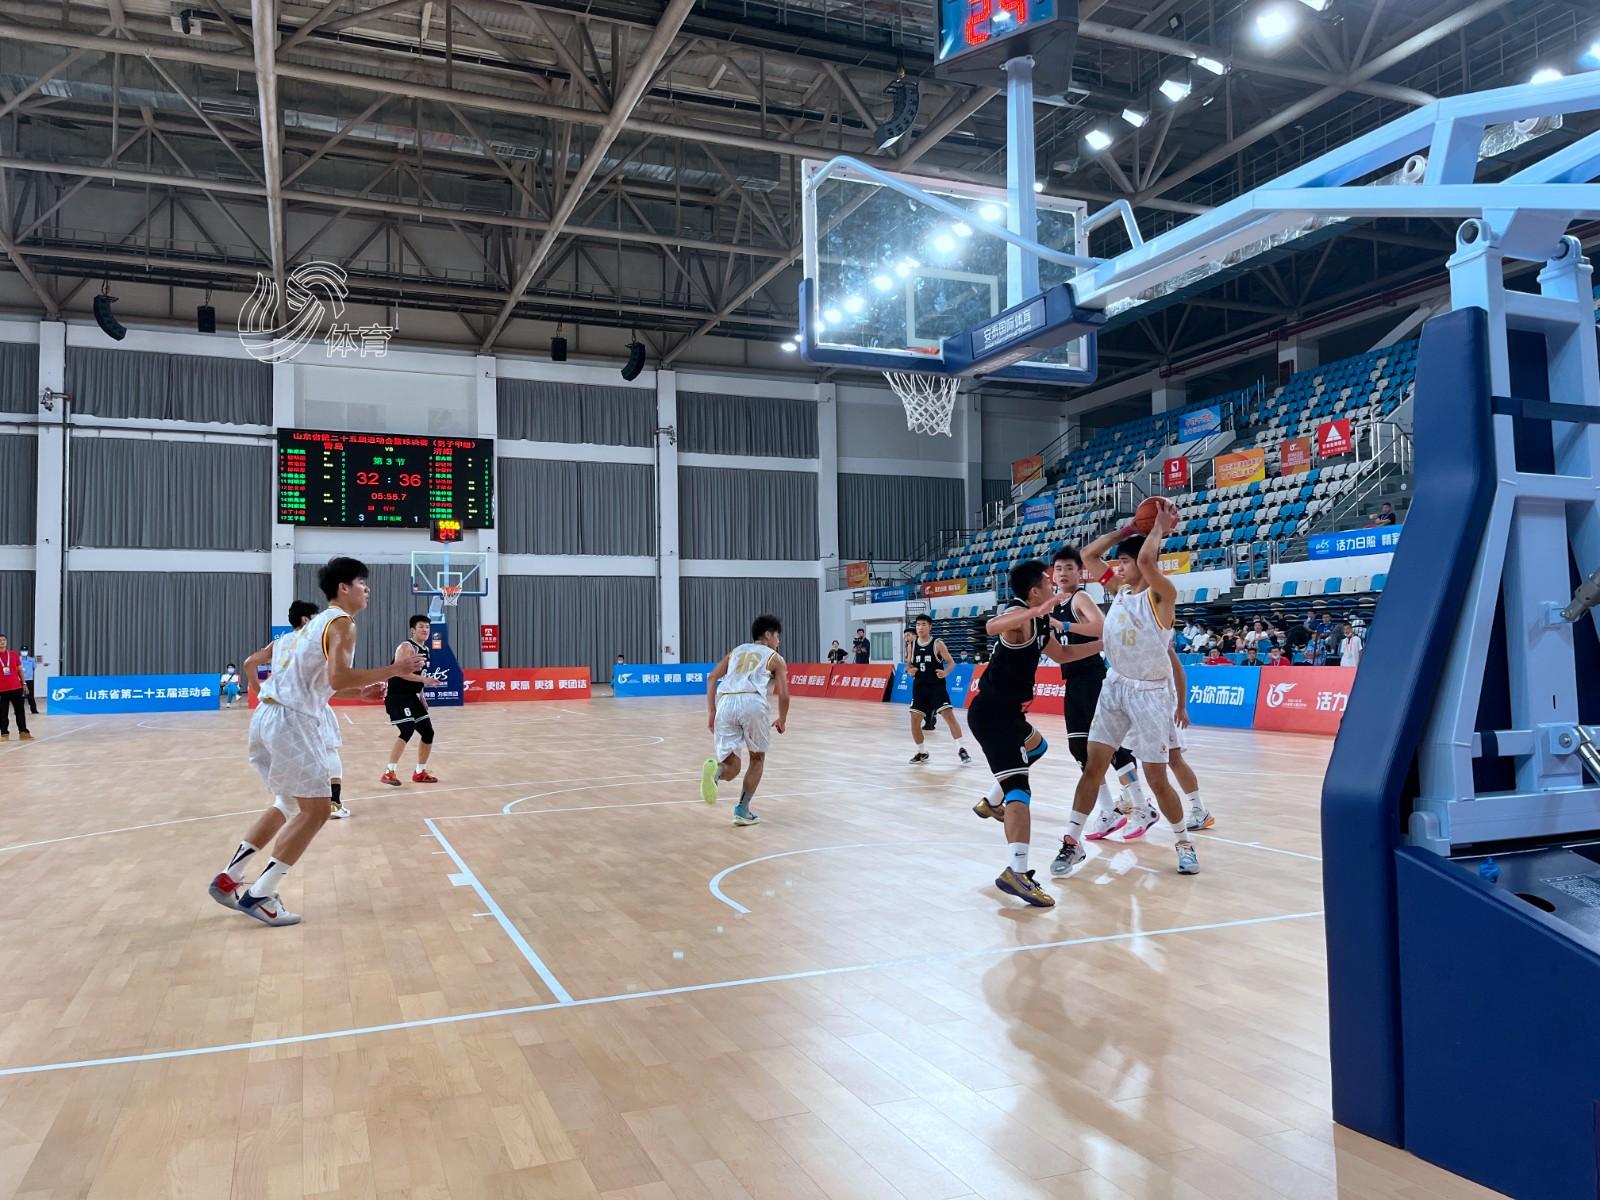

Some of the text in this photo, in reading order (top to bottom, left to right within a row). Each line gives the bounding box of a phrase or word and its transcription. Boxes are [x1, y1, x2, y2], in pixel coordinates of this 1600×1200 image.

[356, 472, 379, 485] 32
[399, 474, 421, 487] 36
[371, 492, 407, 501] 05:55.7
[358, 513, 365, 521] 3
[413, 515, 418, 523] 1
[1336, 536, 1376, 552] 活力日照
[919, 662, 926, 672] 5
[642, 672, 703, 684] 更快 更高 更强
[486, 679, 587, 691] 更快 更高 更强 更团结
[85, 687, 212, 700] 山东省第二十五届运动会
[1189, 685, 1245, 706] 为你而动
[1315, 691, 1348, 712] 活力
[404, 707, 411, 717] 6
